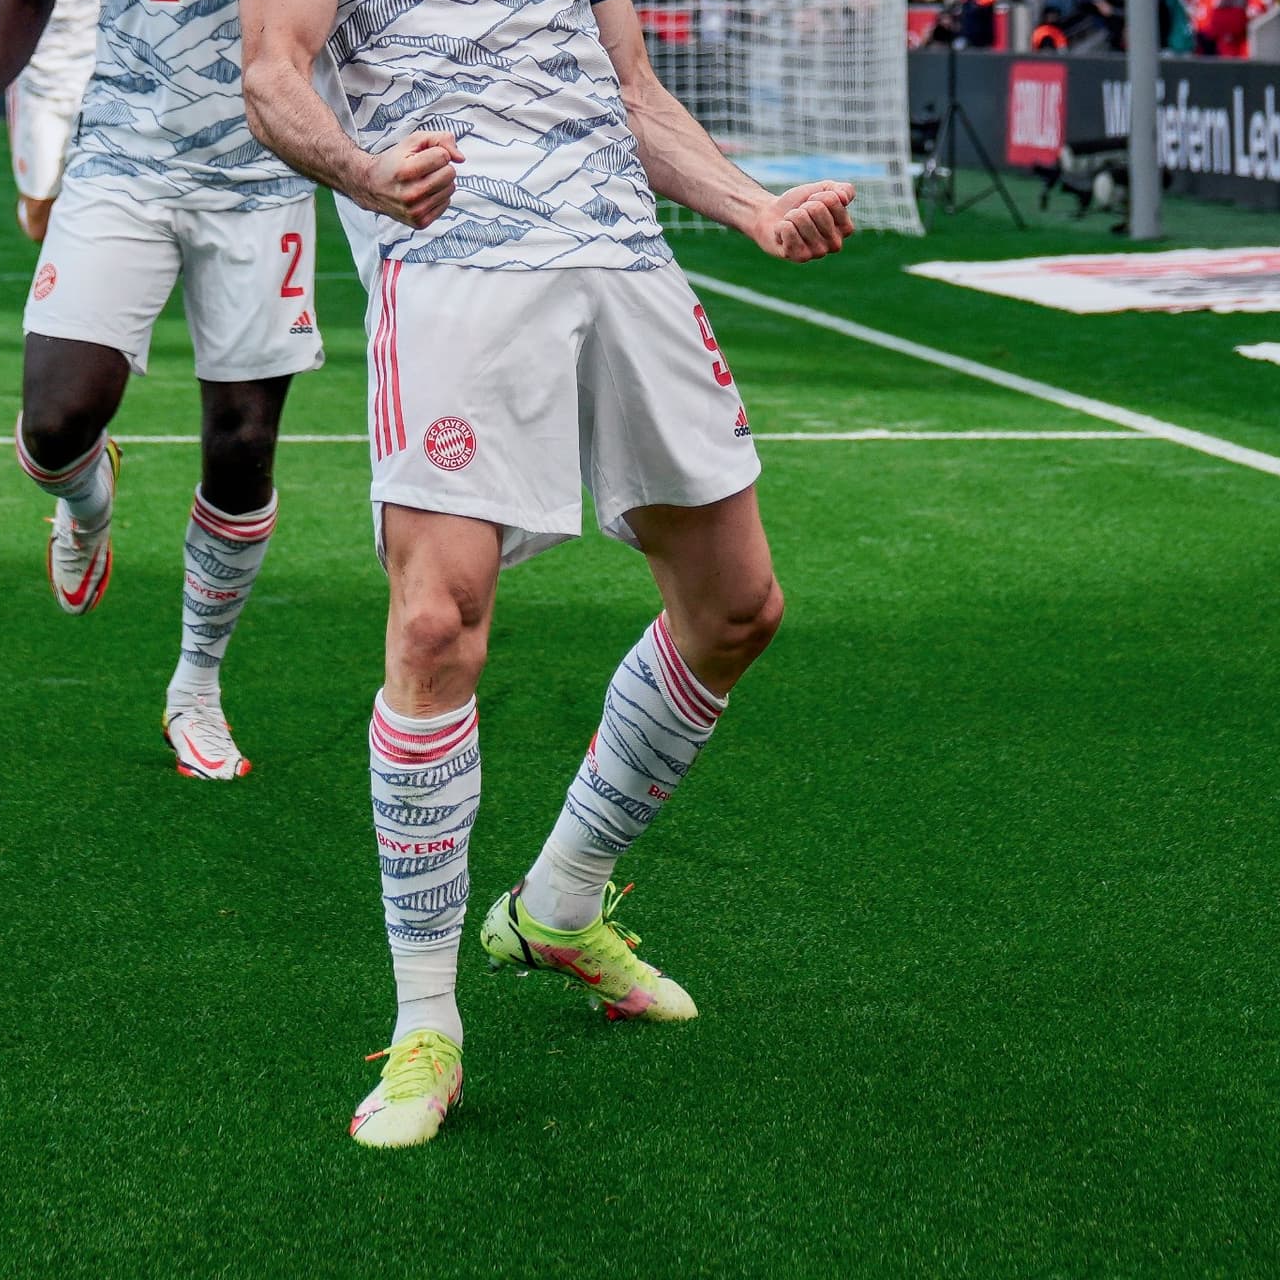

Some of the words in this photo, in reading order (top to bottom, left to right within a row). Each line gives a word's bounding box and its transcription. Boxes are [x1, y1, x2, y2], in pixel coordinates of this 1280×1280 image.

[1157, 78, 1232, 176] iefern
[280, 232, 304, 298] 2
[428, 428, 439, 441] FC
[437, 420, 472, 439] BAYERN
[377, 831, 455, 855] BAYERN
